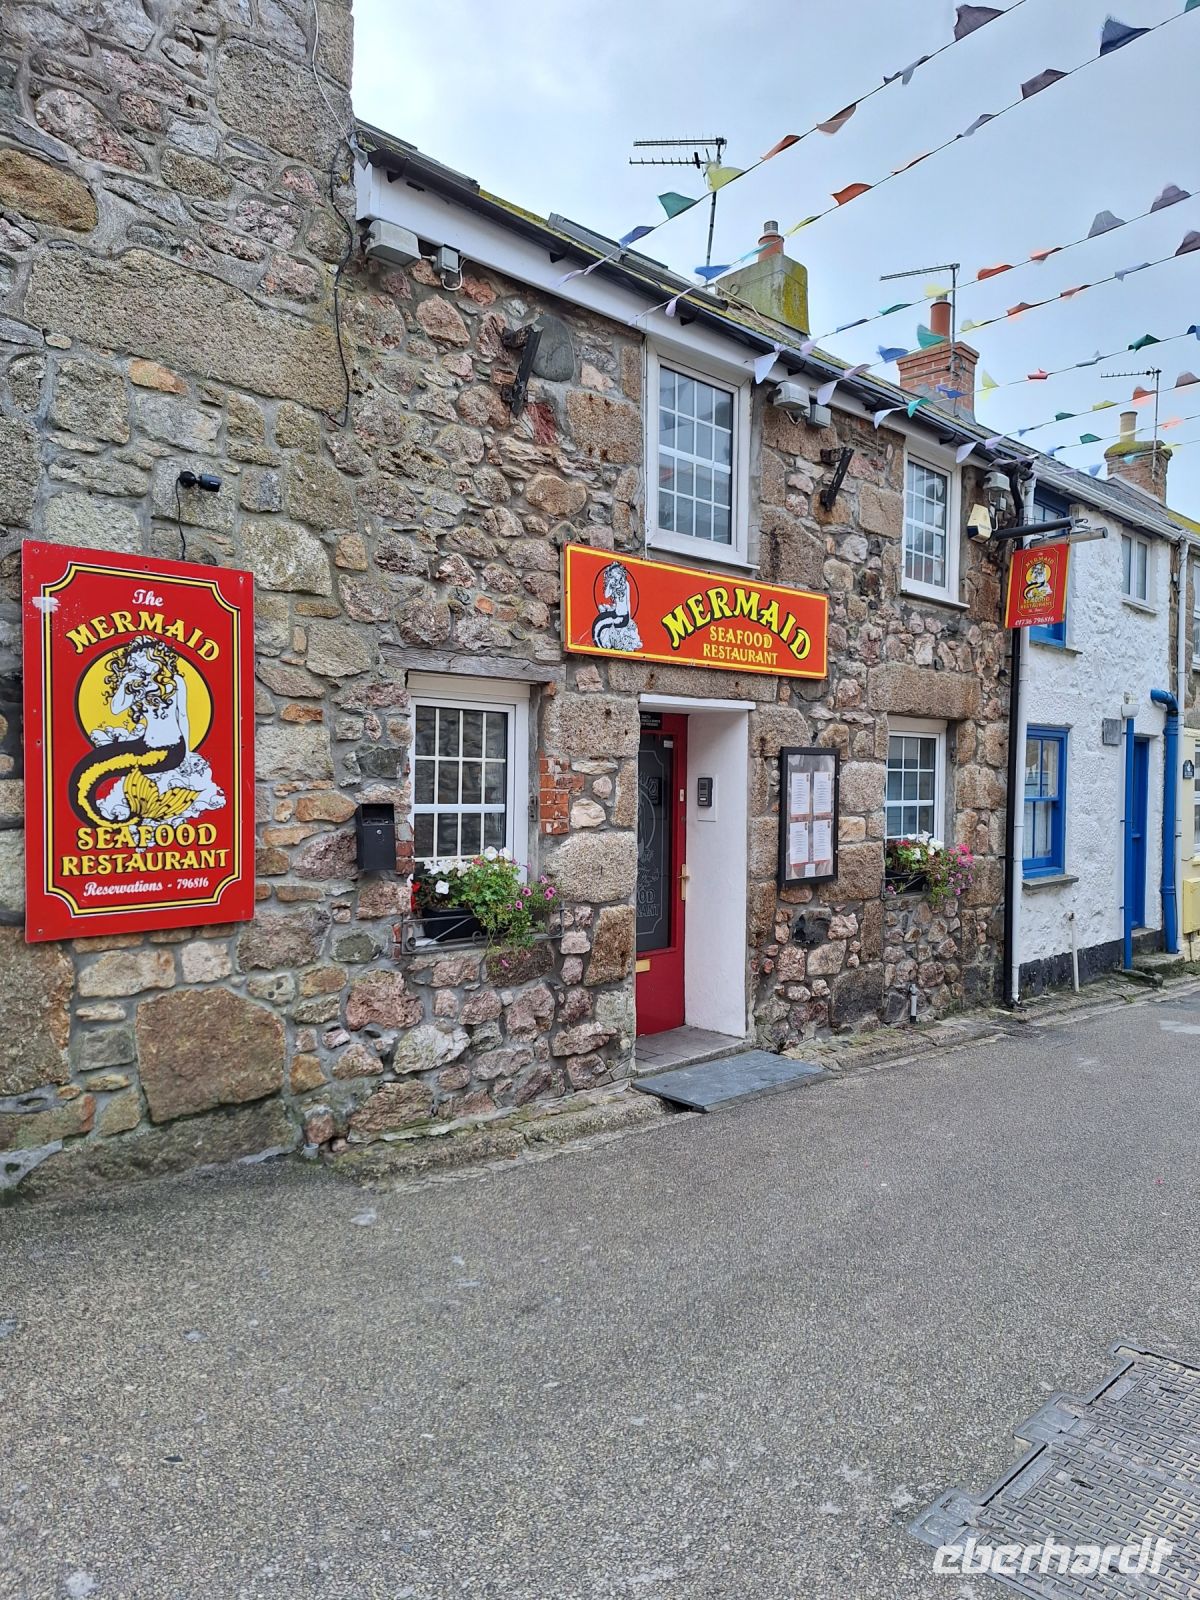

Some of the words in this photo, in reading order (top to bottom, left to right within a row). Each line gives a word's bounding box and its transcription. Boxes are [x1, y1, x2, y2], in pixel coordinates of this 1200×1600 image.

[132, 588, 164, 607] The
[65, 610, 221, 661] MERMAID
[661, 586, 811, 660] MERMAID
[709, 625, 773, 649] SEAFOOD
[703, 643, 778, 665] RESTAURANT
[77, 823, 218, 850] SEAFOOD
[61, 849, 231, 876] RESTAURANT
[83, 880, 163, 897] Reservations
[176, 877, 209, 890] 796816
